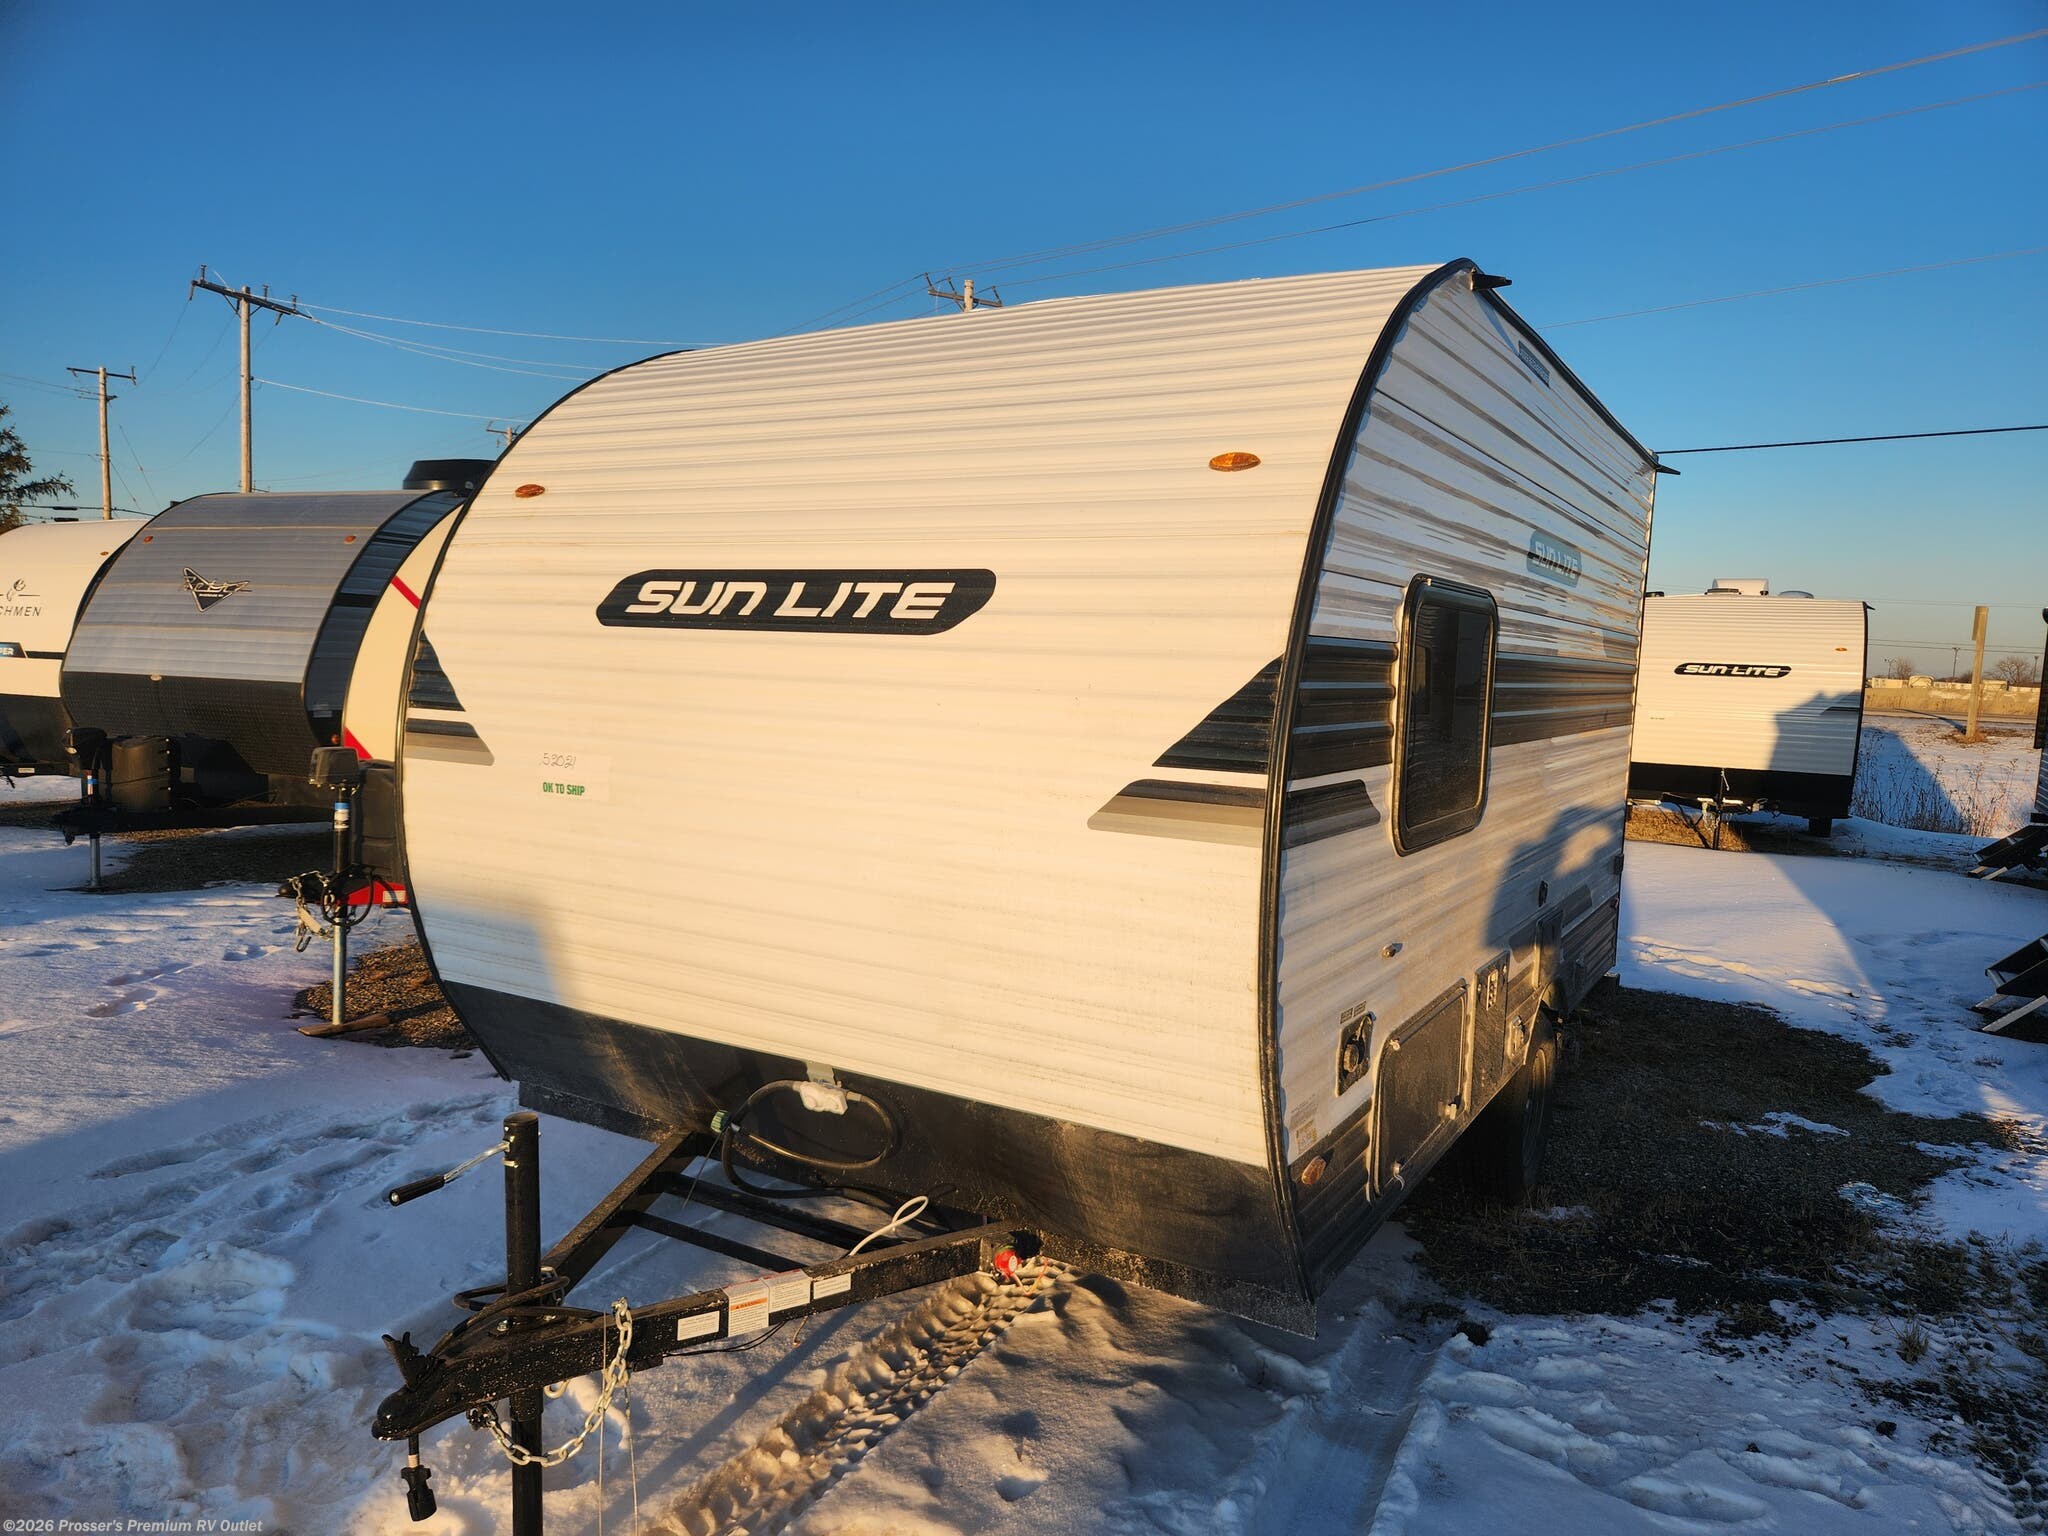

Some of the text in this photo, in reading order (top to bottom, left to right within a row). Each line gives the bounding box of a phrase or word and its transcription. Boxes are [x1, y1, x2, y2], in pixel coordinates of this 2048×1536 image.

[1532, 541, 1578, 579] SUN LITE
[624, 581, 956, 619] SUN LITE
[1683, 664, 1781, 676] SUN LITE
[543, 782, 585, 796] OK TO SHIP
